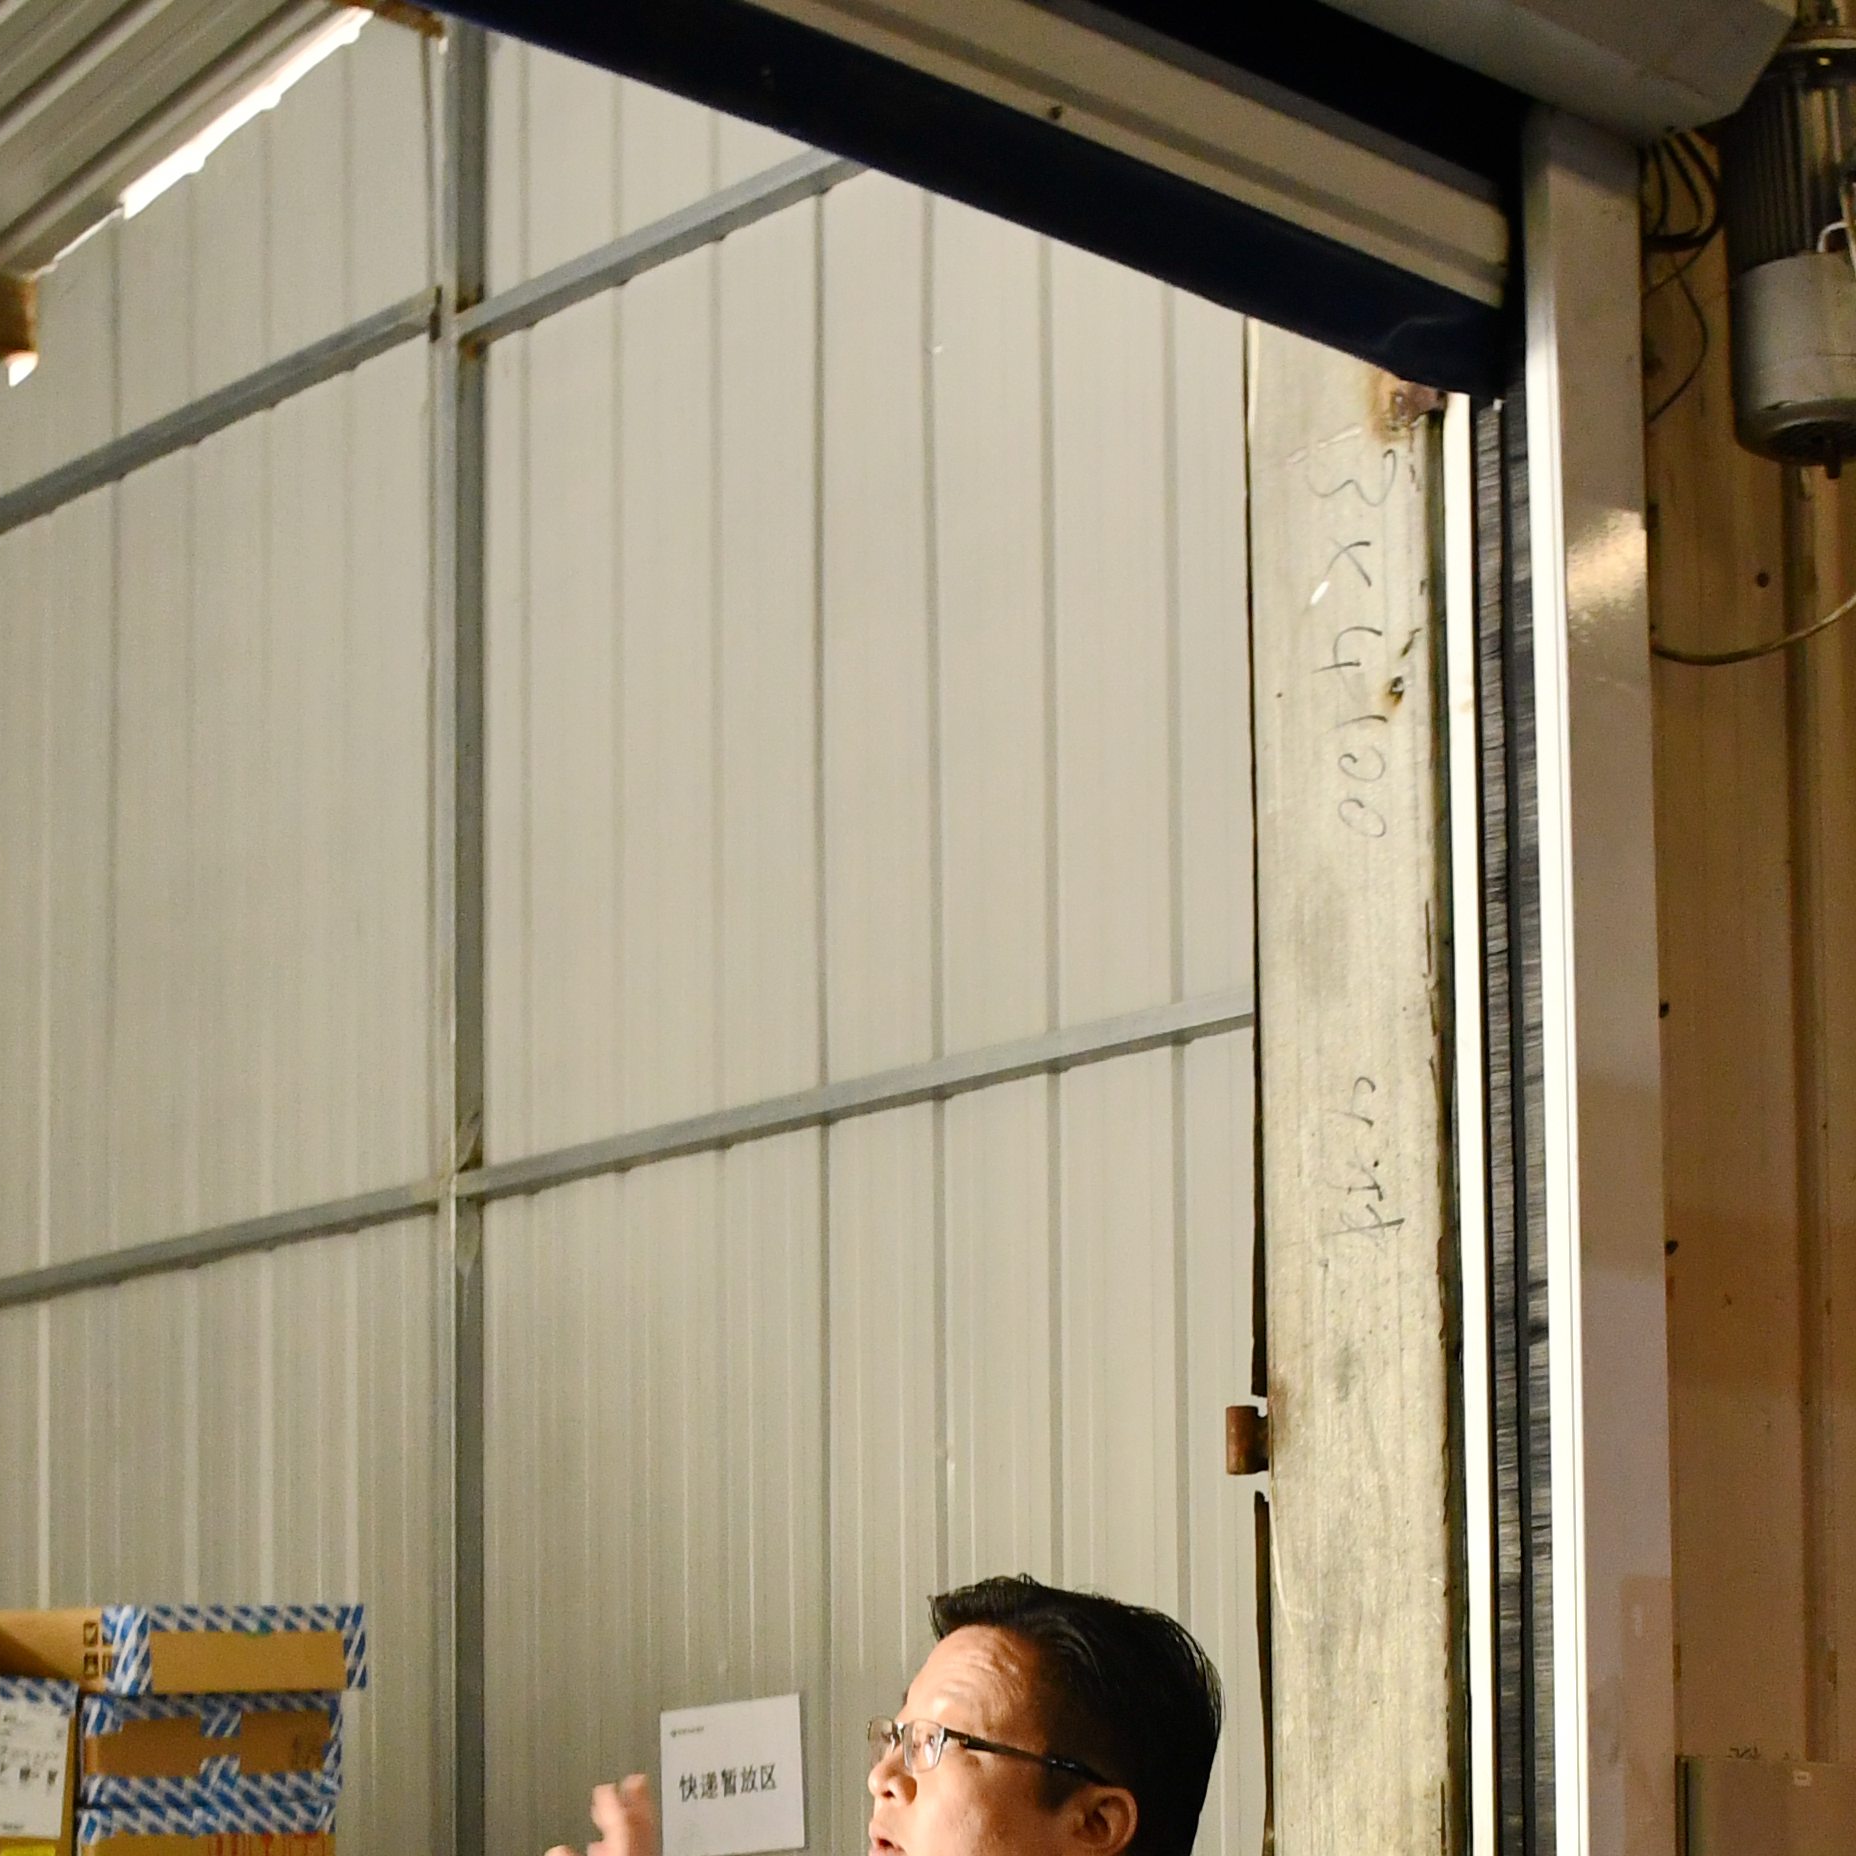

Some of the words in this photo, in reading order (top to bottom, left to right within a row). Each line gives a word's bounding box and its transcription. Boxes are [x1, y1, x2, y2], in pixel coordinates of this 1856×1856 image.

[679, 1762, 777, 1802] 快递暂放区
